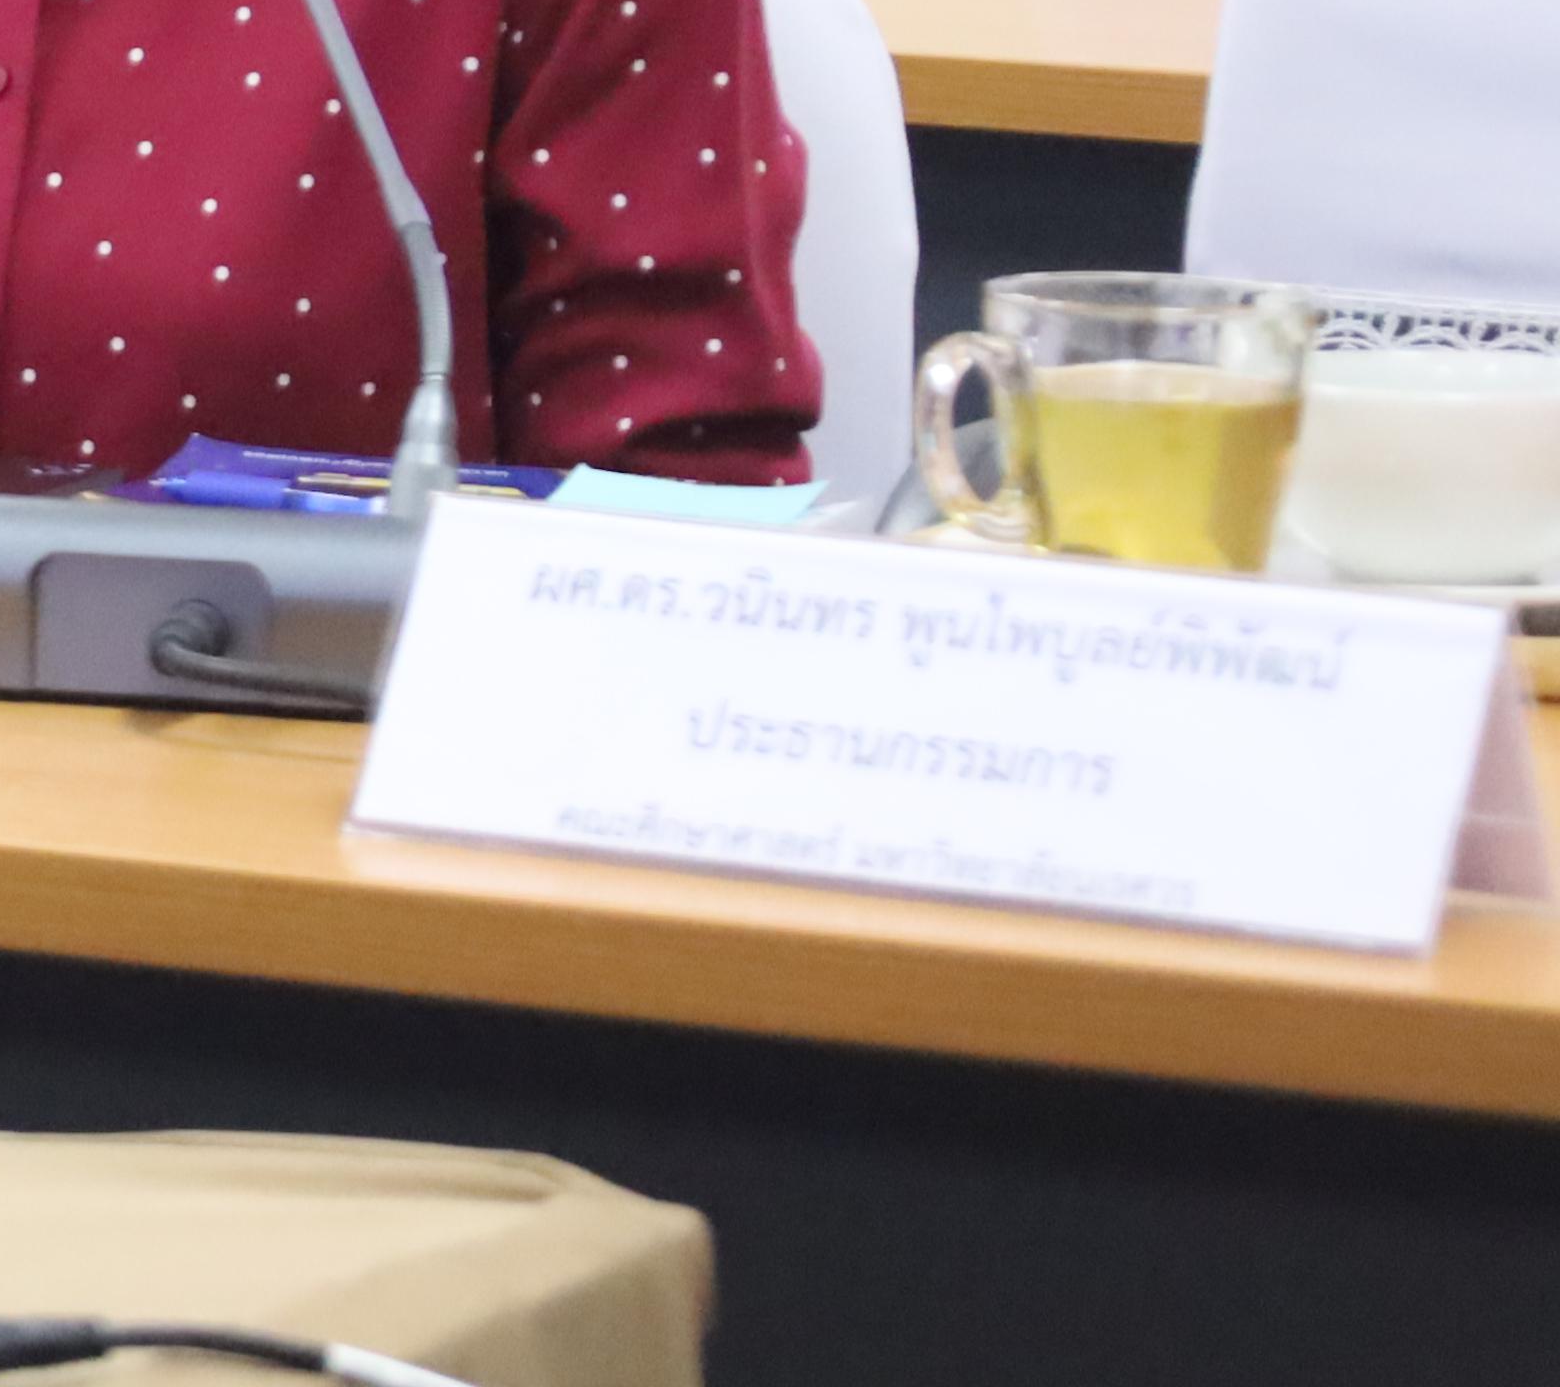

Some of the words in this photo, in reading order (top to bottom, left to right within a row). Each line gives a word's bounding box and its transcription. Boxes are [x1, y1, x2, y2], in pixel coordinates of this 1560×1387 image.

[686, 698, 1116, 797] ประธานกรรมการ
